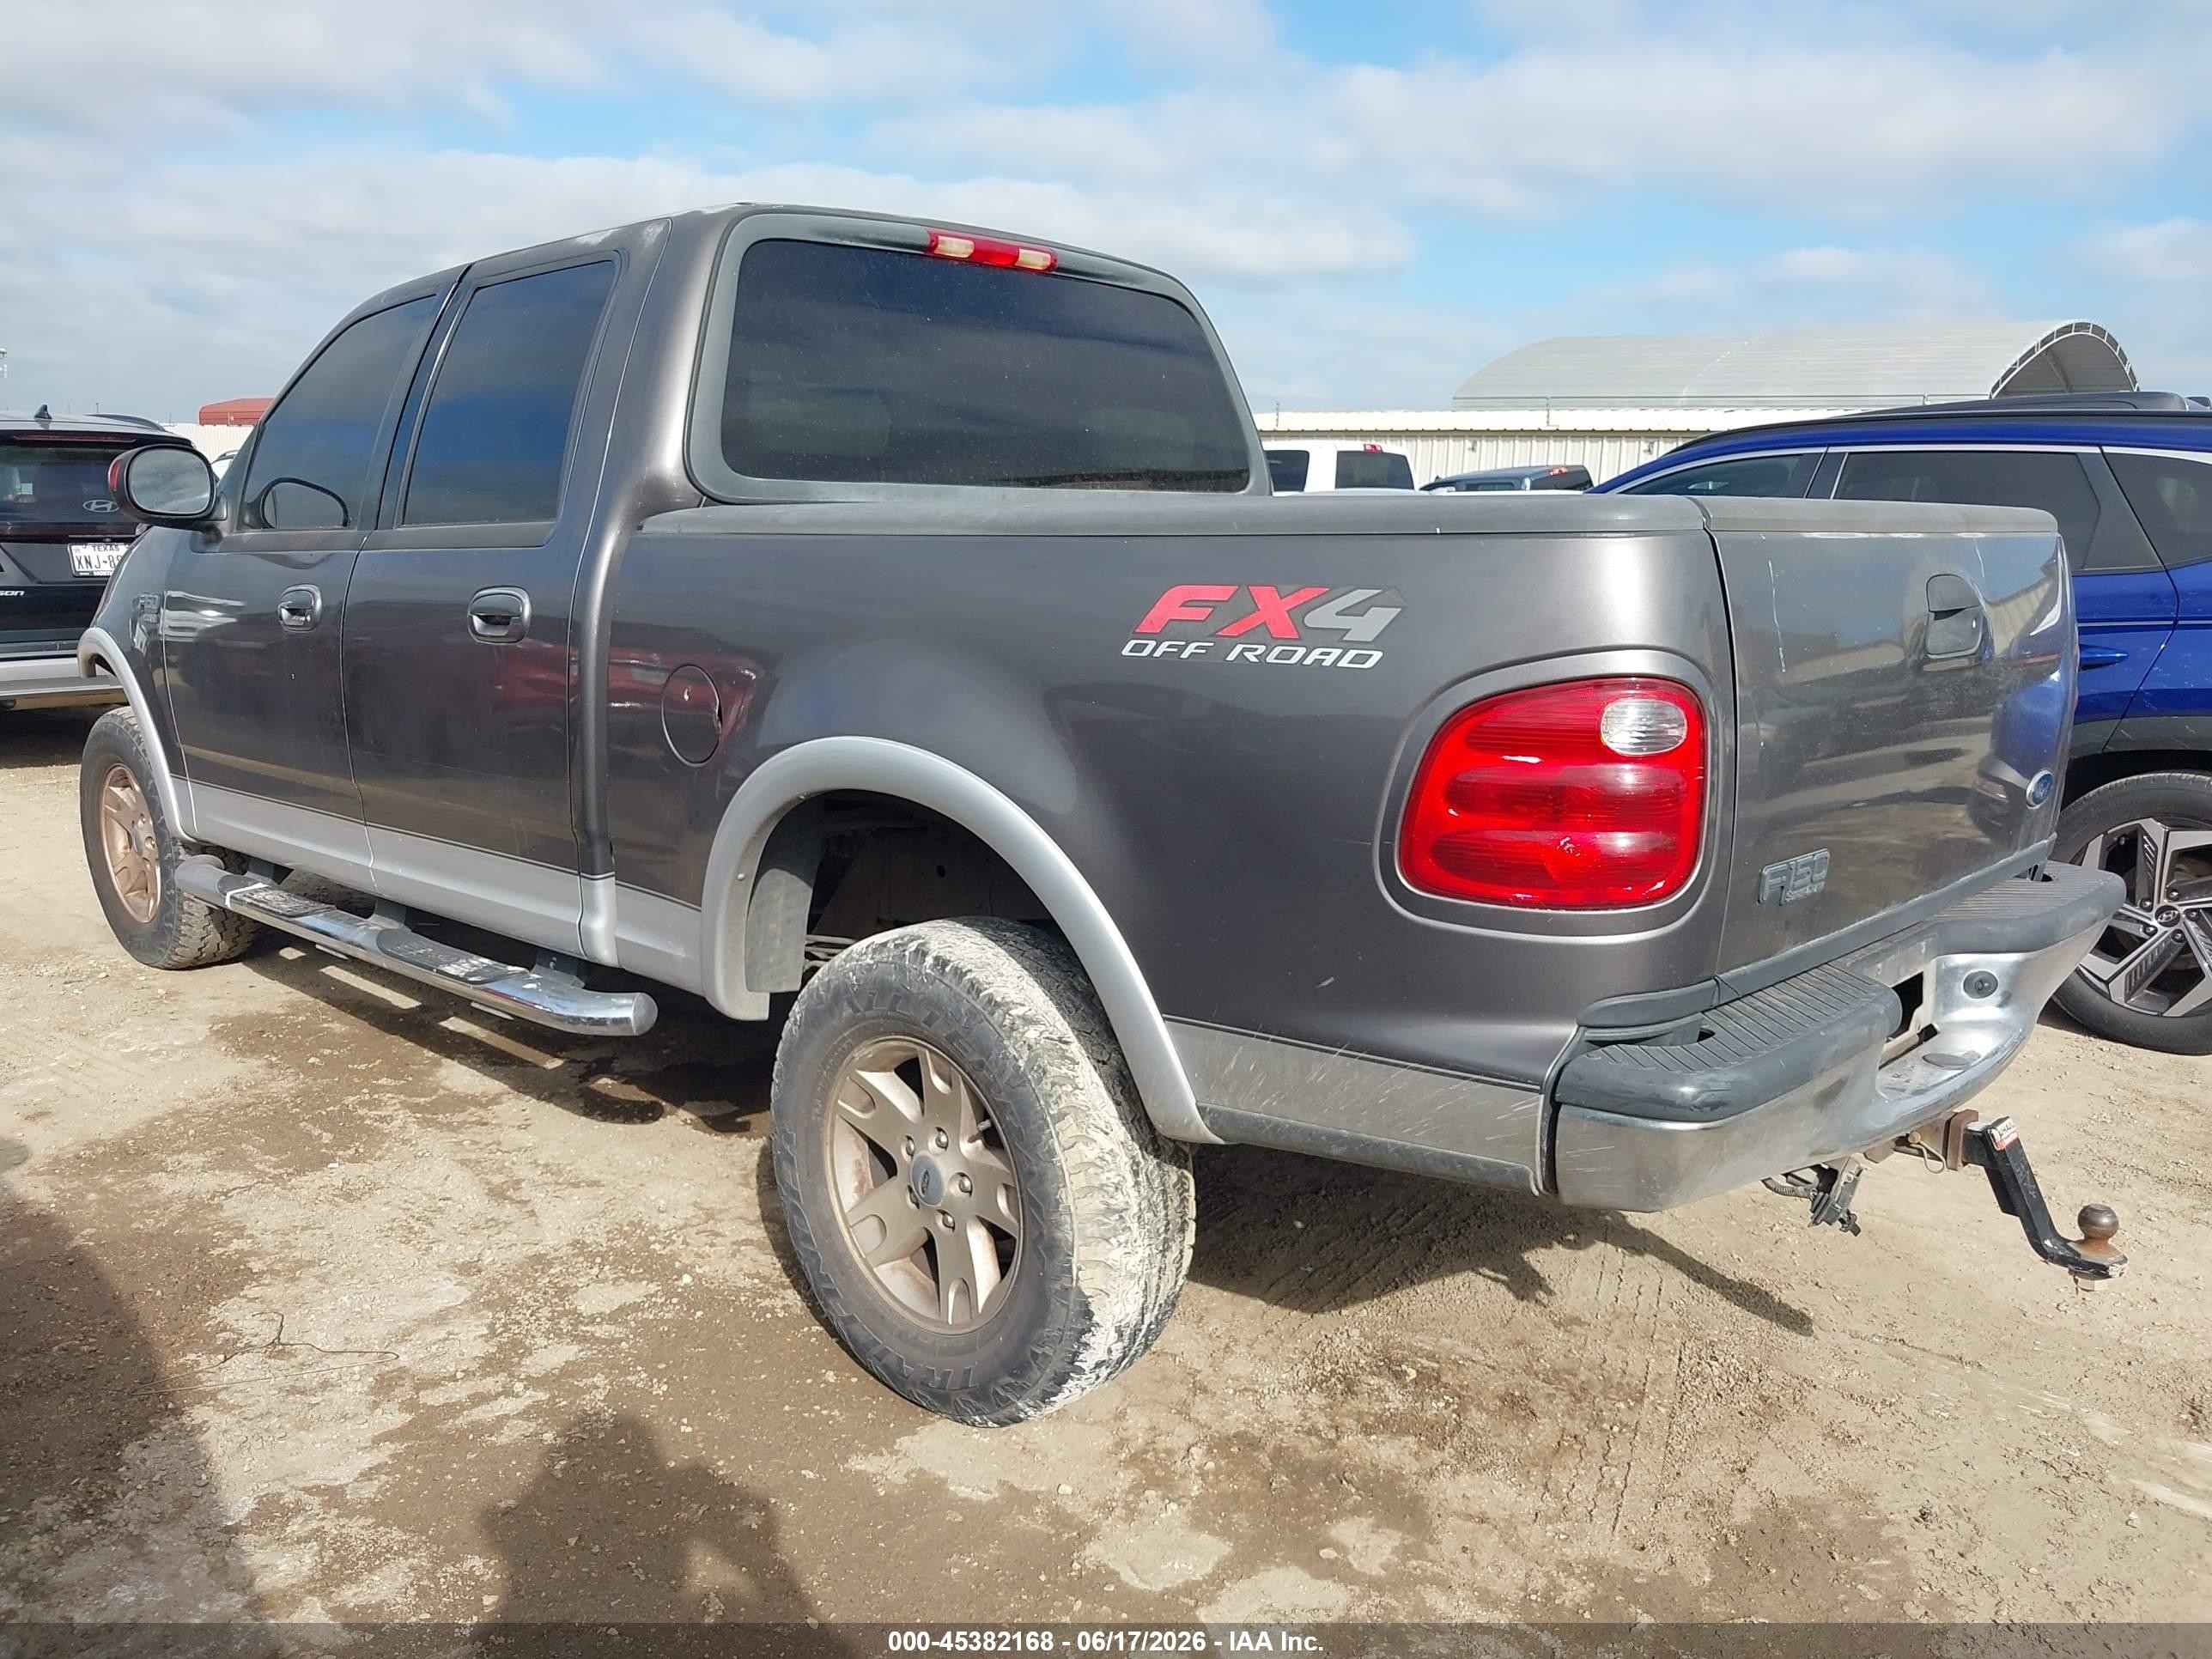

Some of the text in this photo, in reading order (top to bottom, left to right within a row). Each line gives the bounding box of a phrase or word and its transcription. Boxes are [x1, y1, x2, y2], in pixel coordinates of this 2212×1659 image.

[1133, 584, 1403, 642] FX4
[1121, 639, 1384, 669] OFF ROAD
